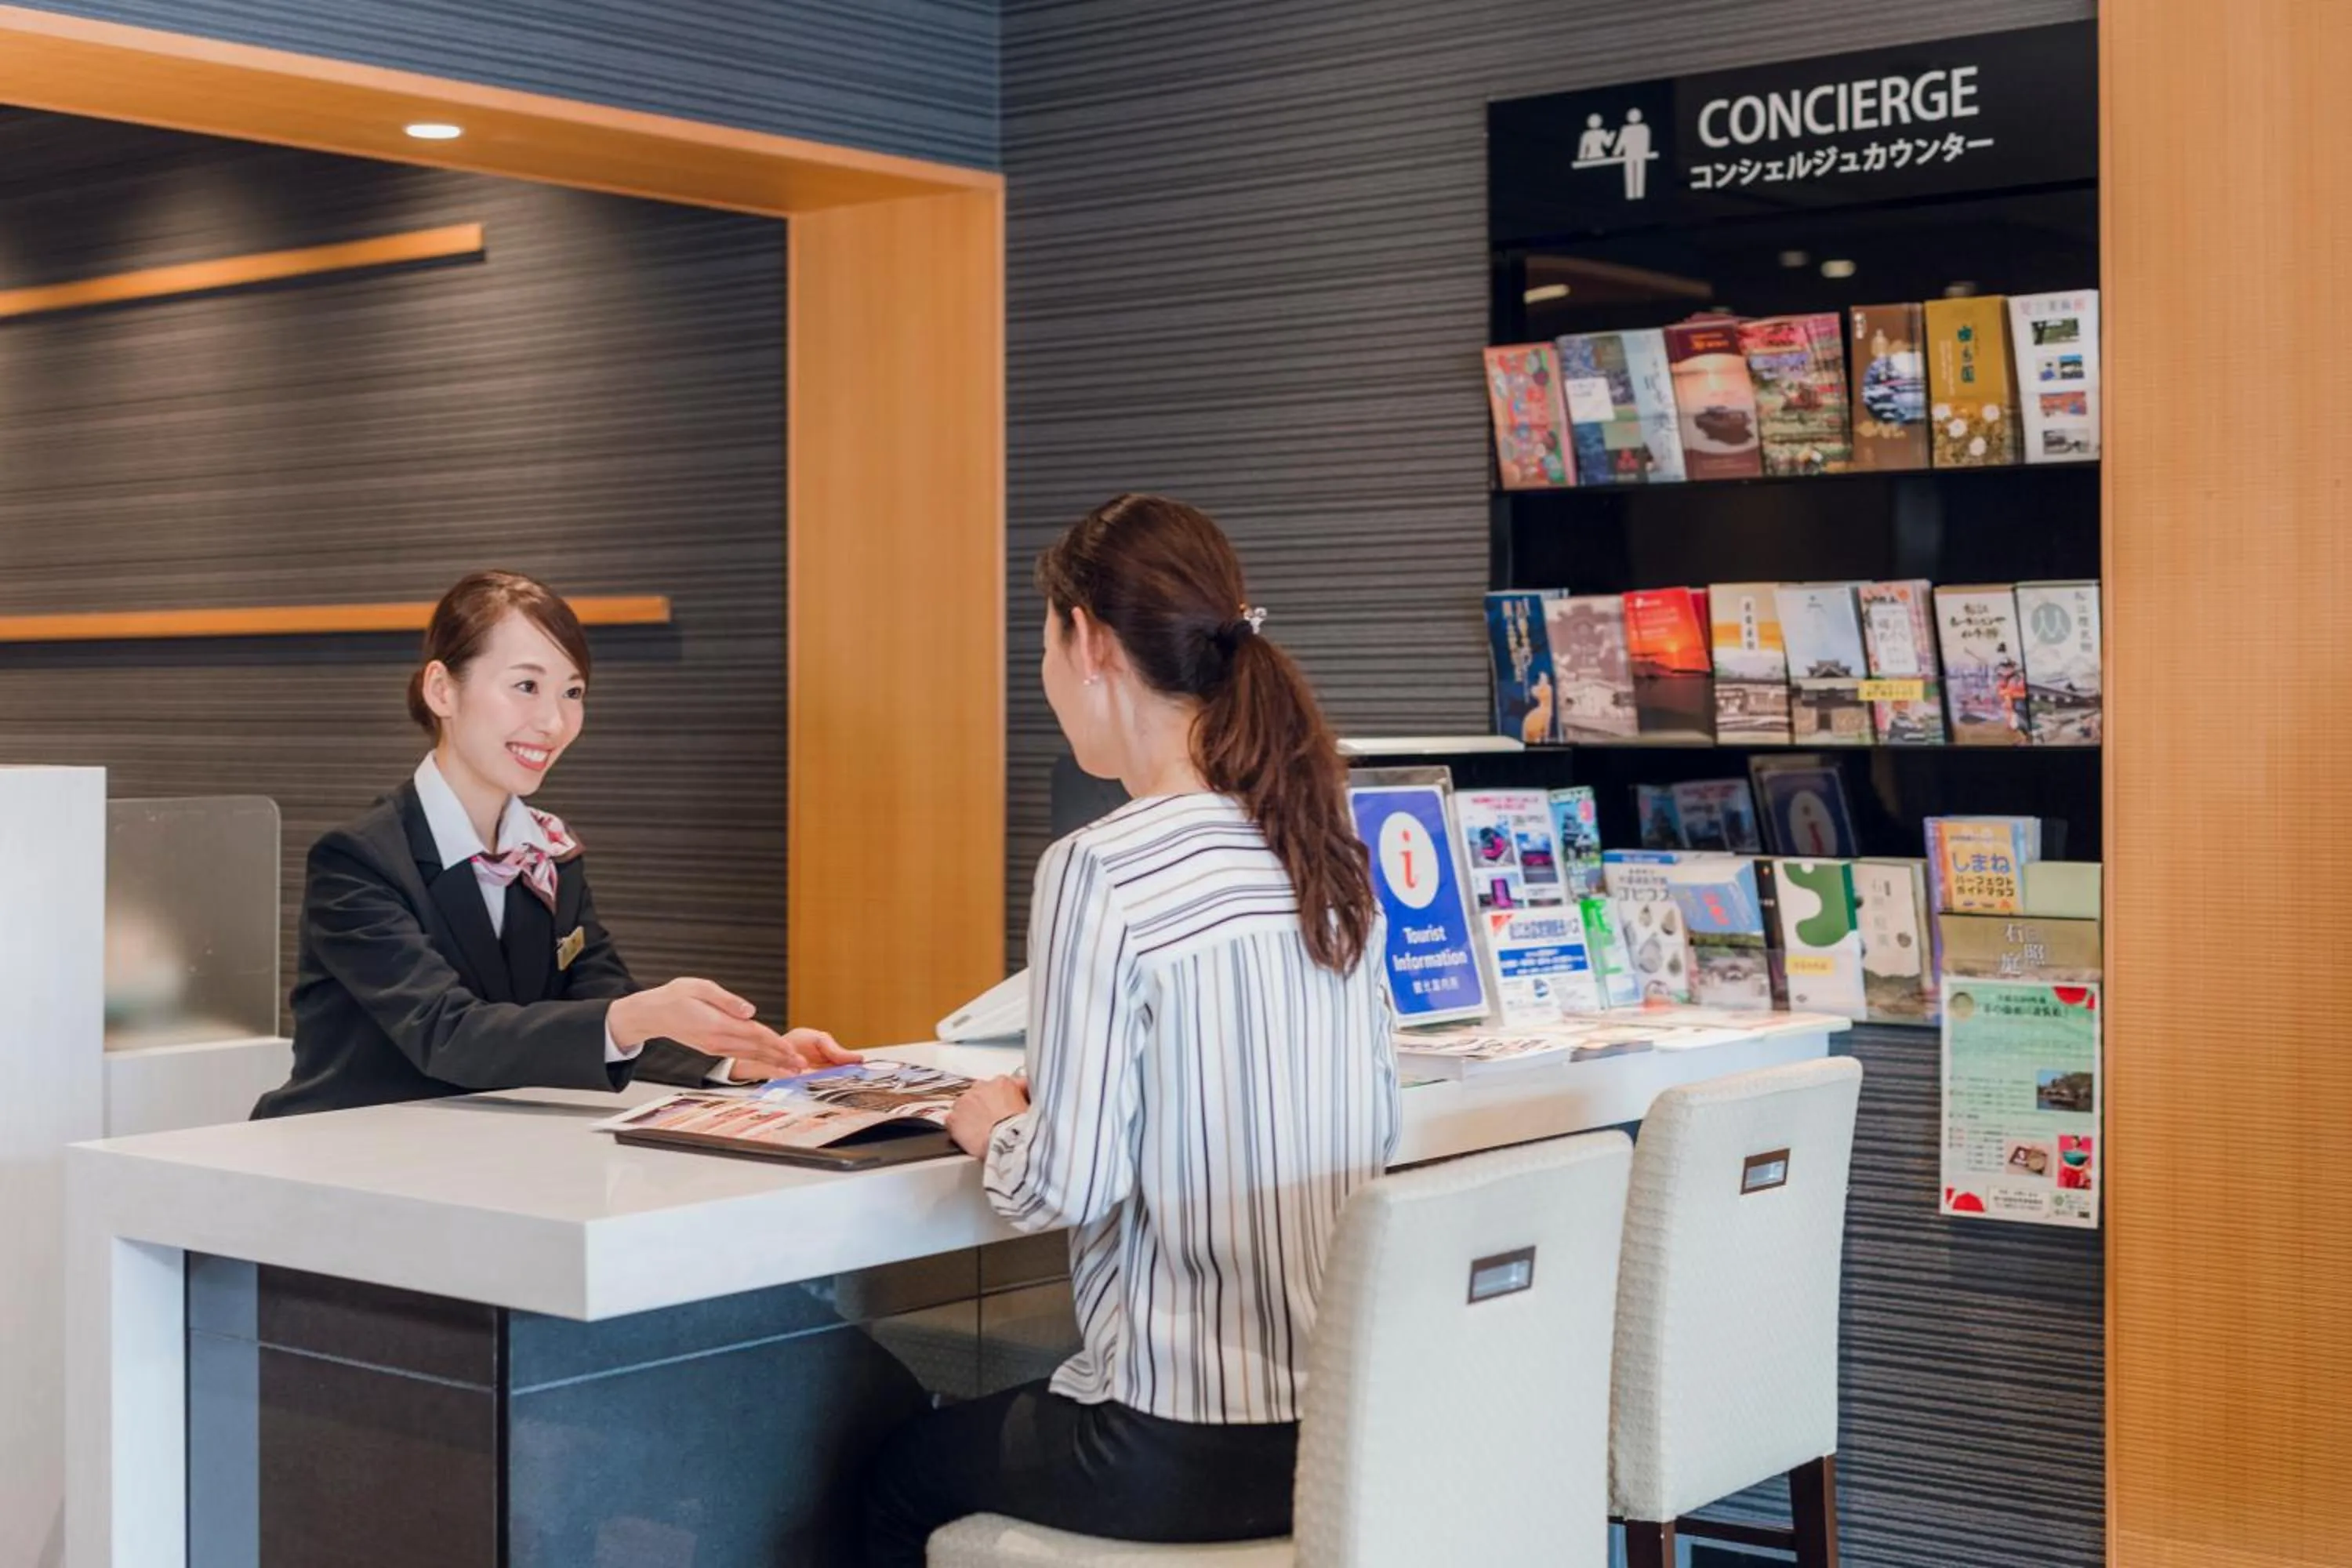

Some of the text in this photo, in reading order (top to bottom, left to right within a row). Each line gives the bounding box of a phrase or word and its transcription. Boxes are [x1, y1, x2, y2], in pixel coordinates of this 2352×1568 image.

[1697, 66, 1980, 149] CONCIERGE
[1690, 132, 1995, 191] コンシェルジュカウンター
[1951, 852, 2011, 873] しまね
[1402, 924, 1447, 945] Tourist
[1392, 947, 1468, 971] Information
